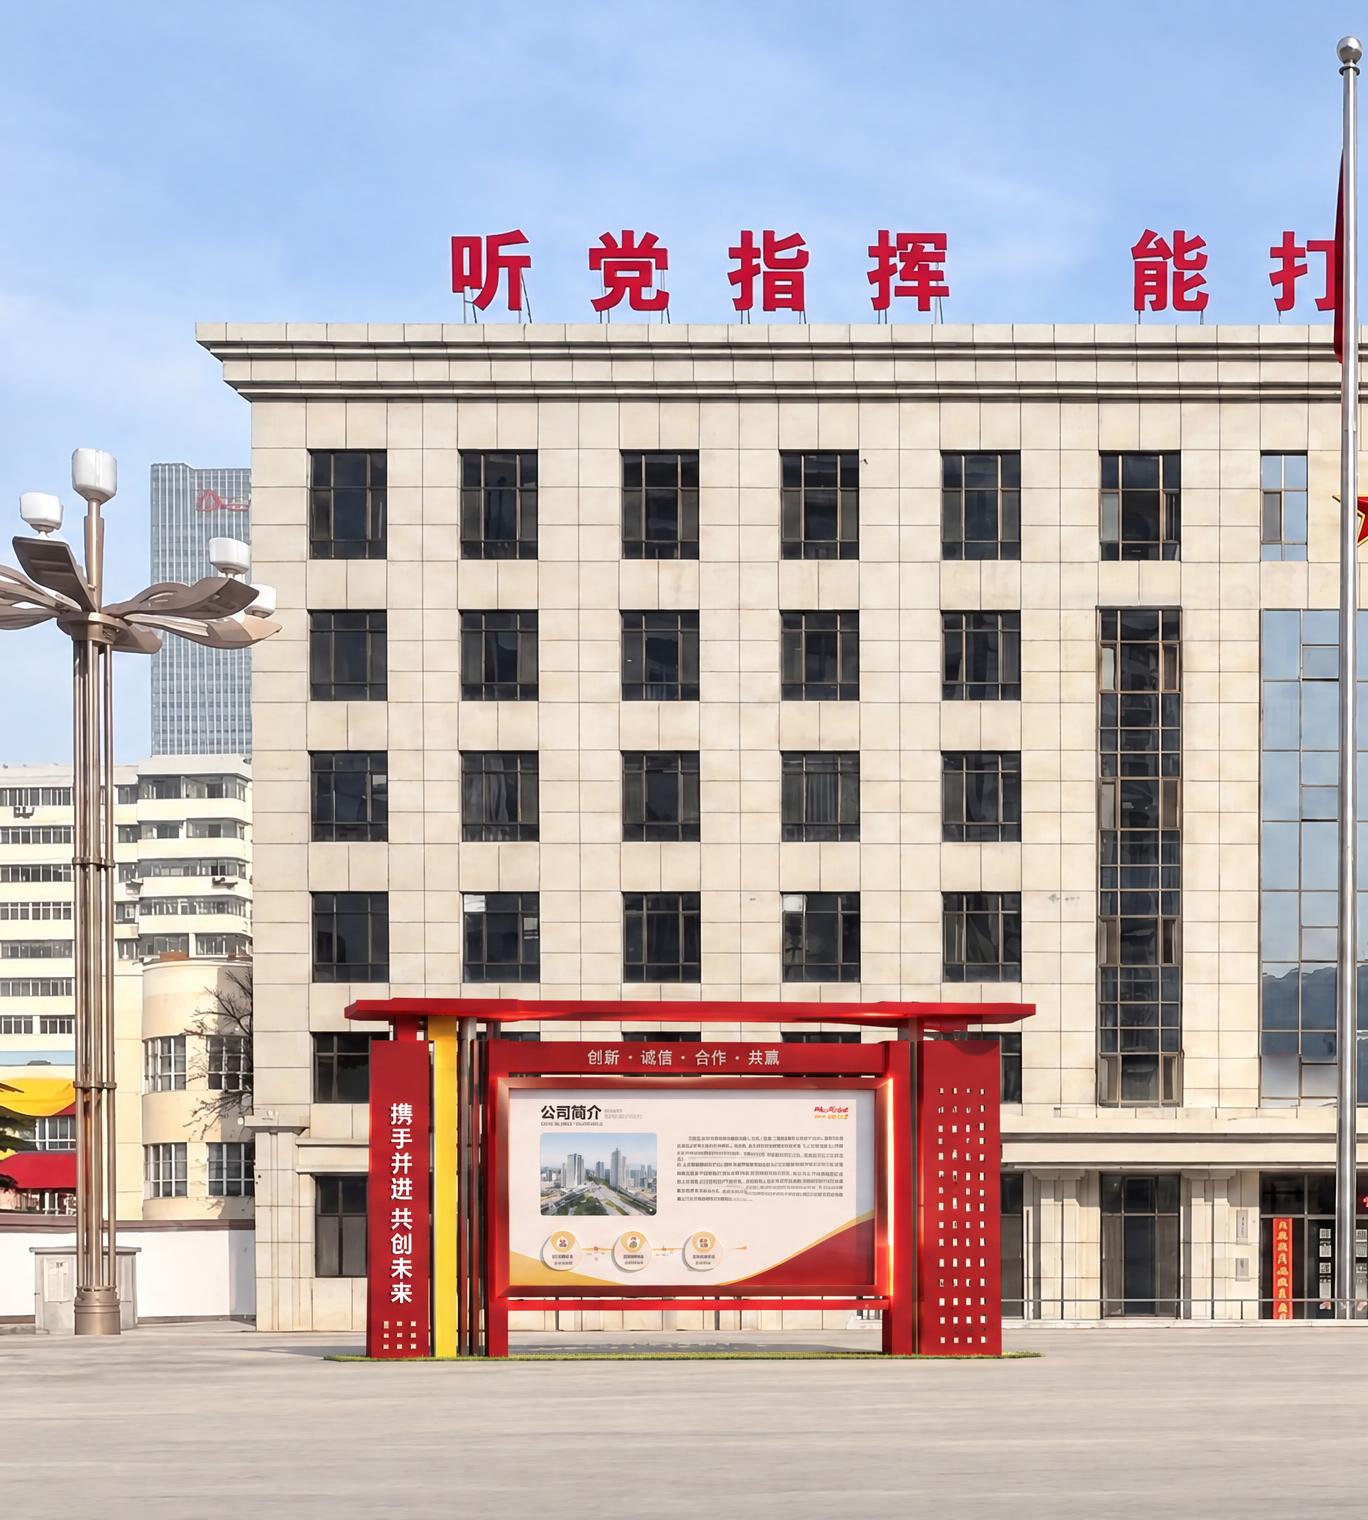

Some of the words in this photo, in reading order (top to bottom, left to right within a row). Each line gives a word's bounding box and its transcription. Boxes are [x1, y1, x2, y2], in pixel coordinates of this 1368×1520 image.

[451, 229, 950, 312] 听党指挥
[587, 1049, 620, 1065] 创新
[640, 1049, 673, 1066] 诚信
[695, 1049, 727, 1066] 合作
[390, 1102, 413, 1201] 携手并进
[540, 1104, 602, 1120] 公司简介
[390, 1207, 413, 1304] 共创未来
